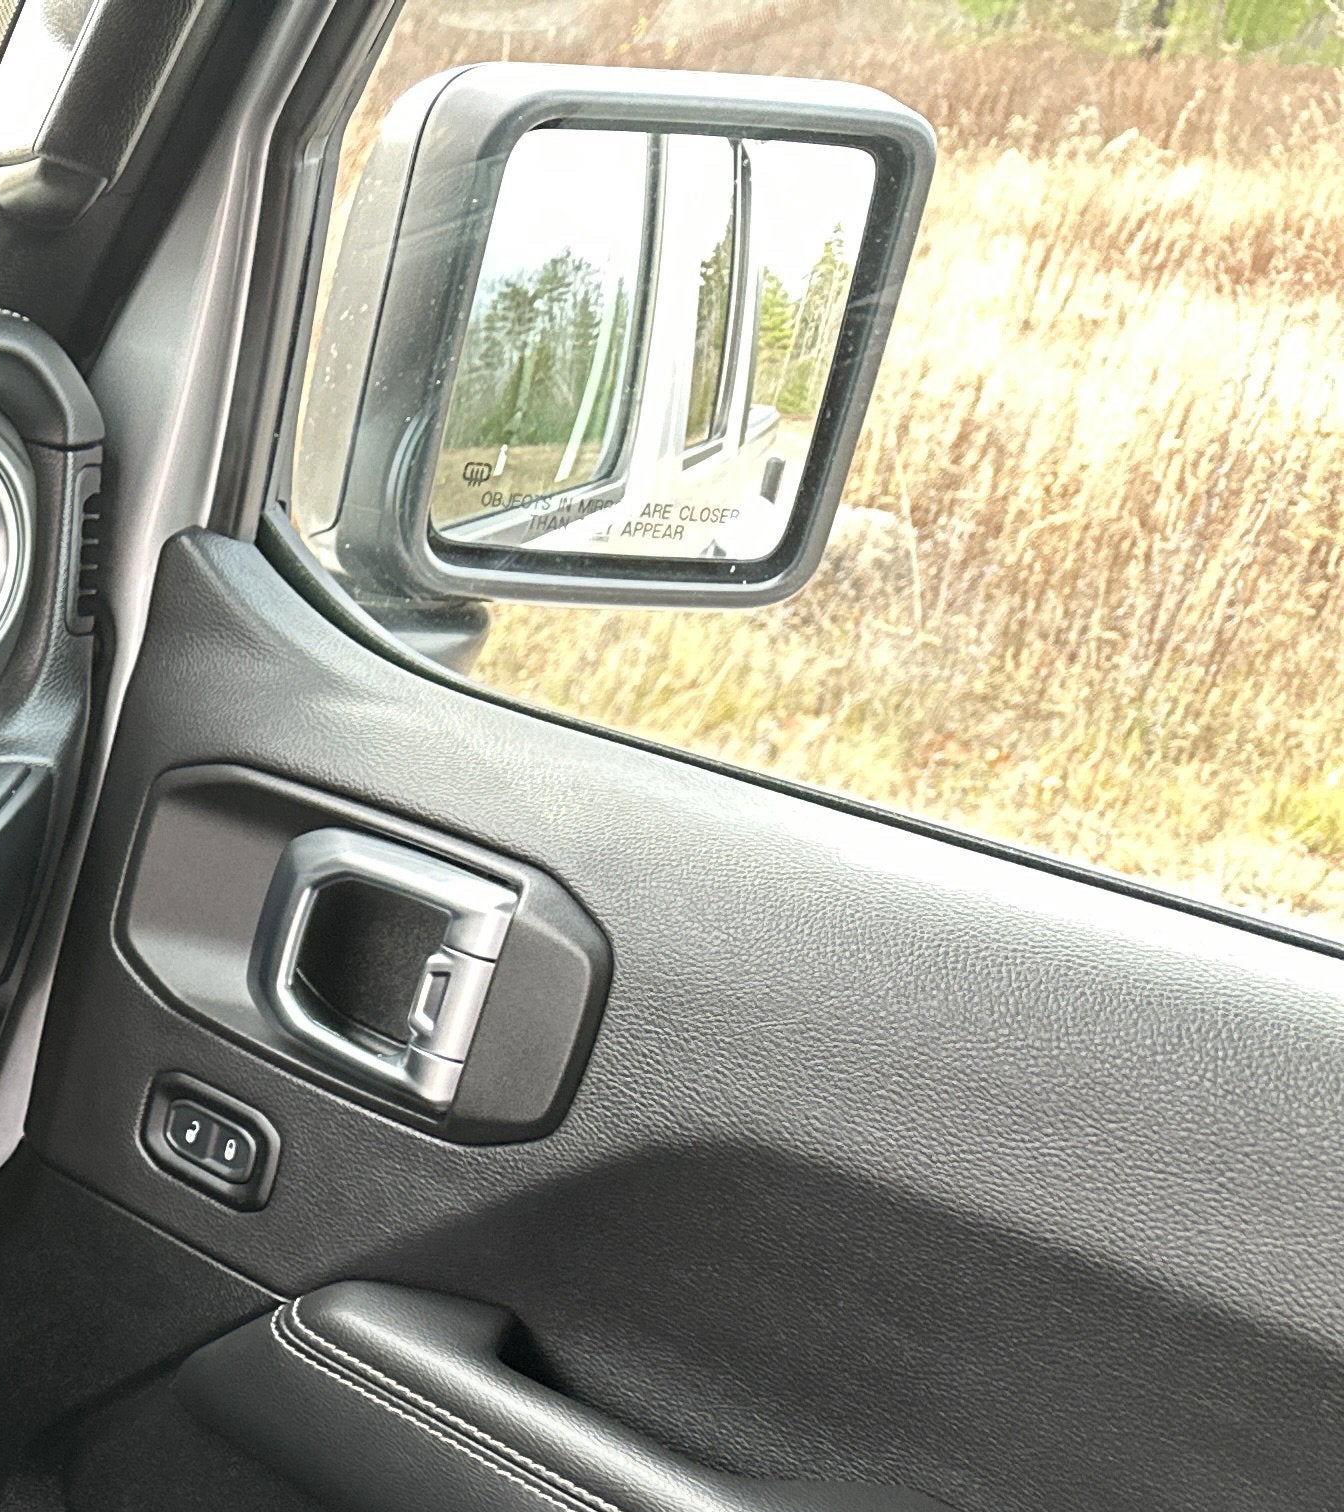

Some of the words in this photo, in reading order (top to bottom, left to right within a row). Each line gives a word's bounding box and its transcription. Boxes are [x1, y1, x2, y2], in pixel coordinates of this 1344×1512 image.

[481, 490, 552, 510] OBJECTS
[558, 498, 572, 512] IN
[640, 502, 673, 519] ARE
[679, 505, 740, 524] CLOSER
[621, 521, 685, 540] APPEAR
